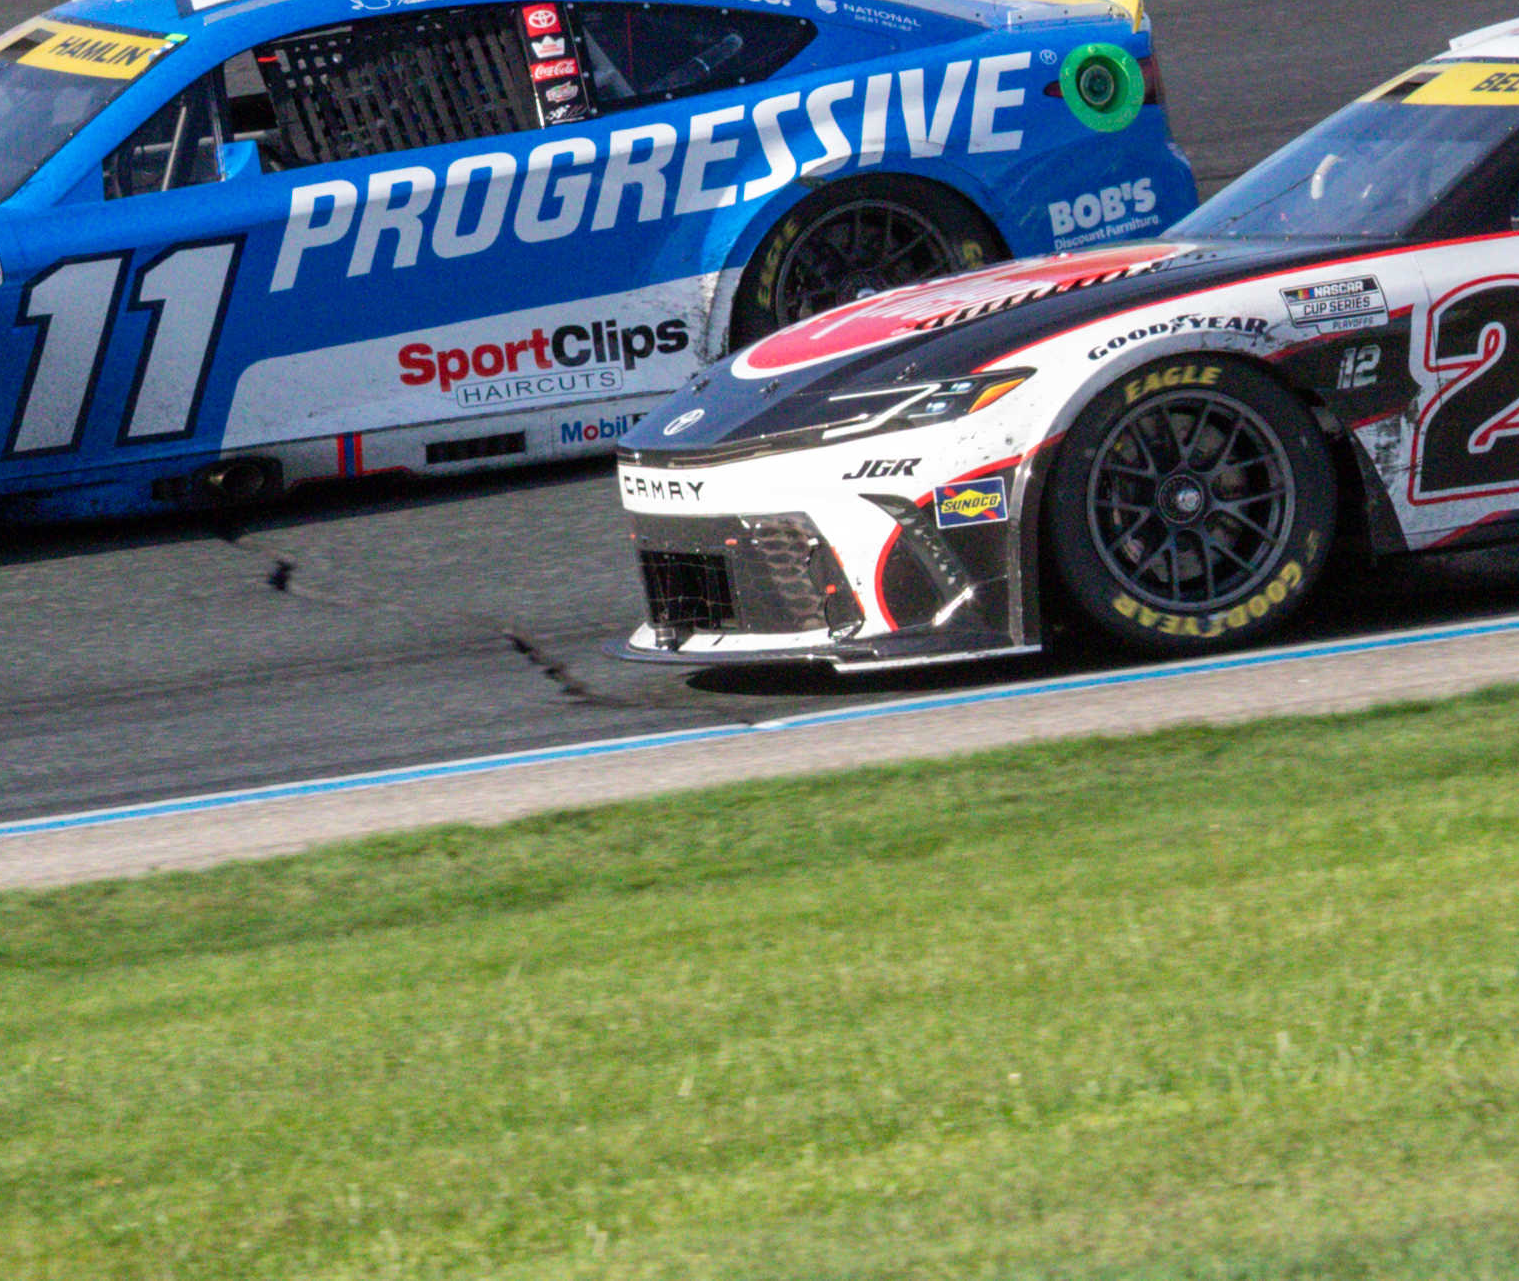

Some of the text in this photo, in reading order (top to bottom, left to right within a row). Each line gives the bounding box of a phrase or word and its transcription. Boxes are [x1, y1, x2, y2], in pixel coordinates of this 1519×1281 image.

[843, 3, 922, 28] NATIONAL
[48, 36, 152, 67] HAMLIN
[269, 50, 1033, 293] PROGRESSIVE
[1048, 177, 1157, 237] BOB'S
[1053, 228, 1107, 252] Discount
[1313, 280, 1364, 299] NASCAR
[1303, 296, 1371, 316] CUP SERIES
[8, 238, 242, 457] 11
[1087, 312, 1270, 362] GOODYEAR
[1336, 344, 1382, 390] 12
[462, 370, 617, 404] HAIRCUTS
[1123, 364, 1224, 406] EAGLE
[560, 415, 629, 445] Mobil
[842, 457, 923, 481] JGR
[623, 475, 705, 502] CAMRY
[941, 494, 1003, 513] SUNOCO
[1111, 560, 1303, 639] GOODYEAR
